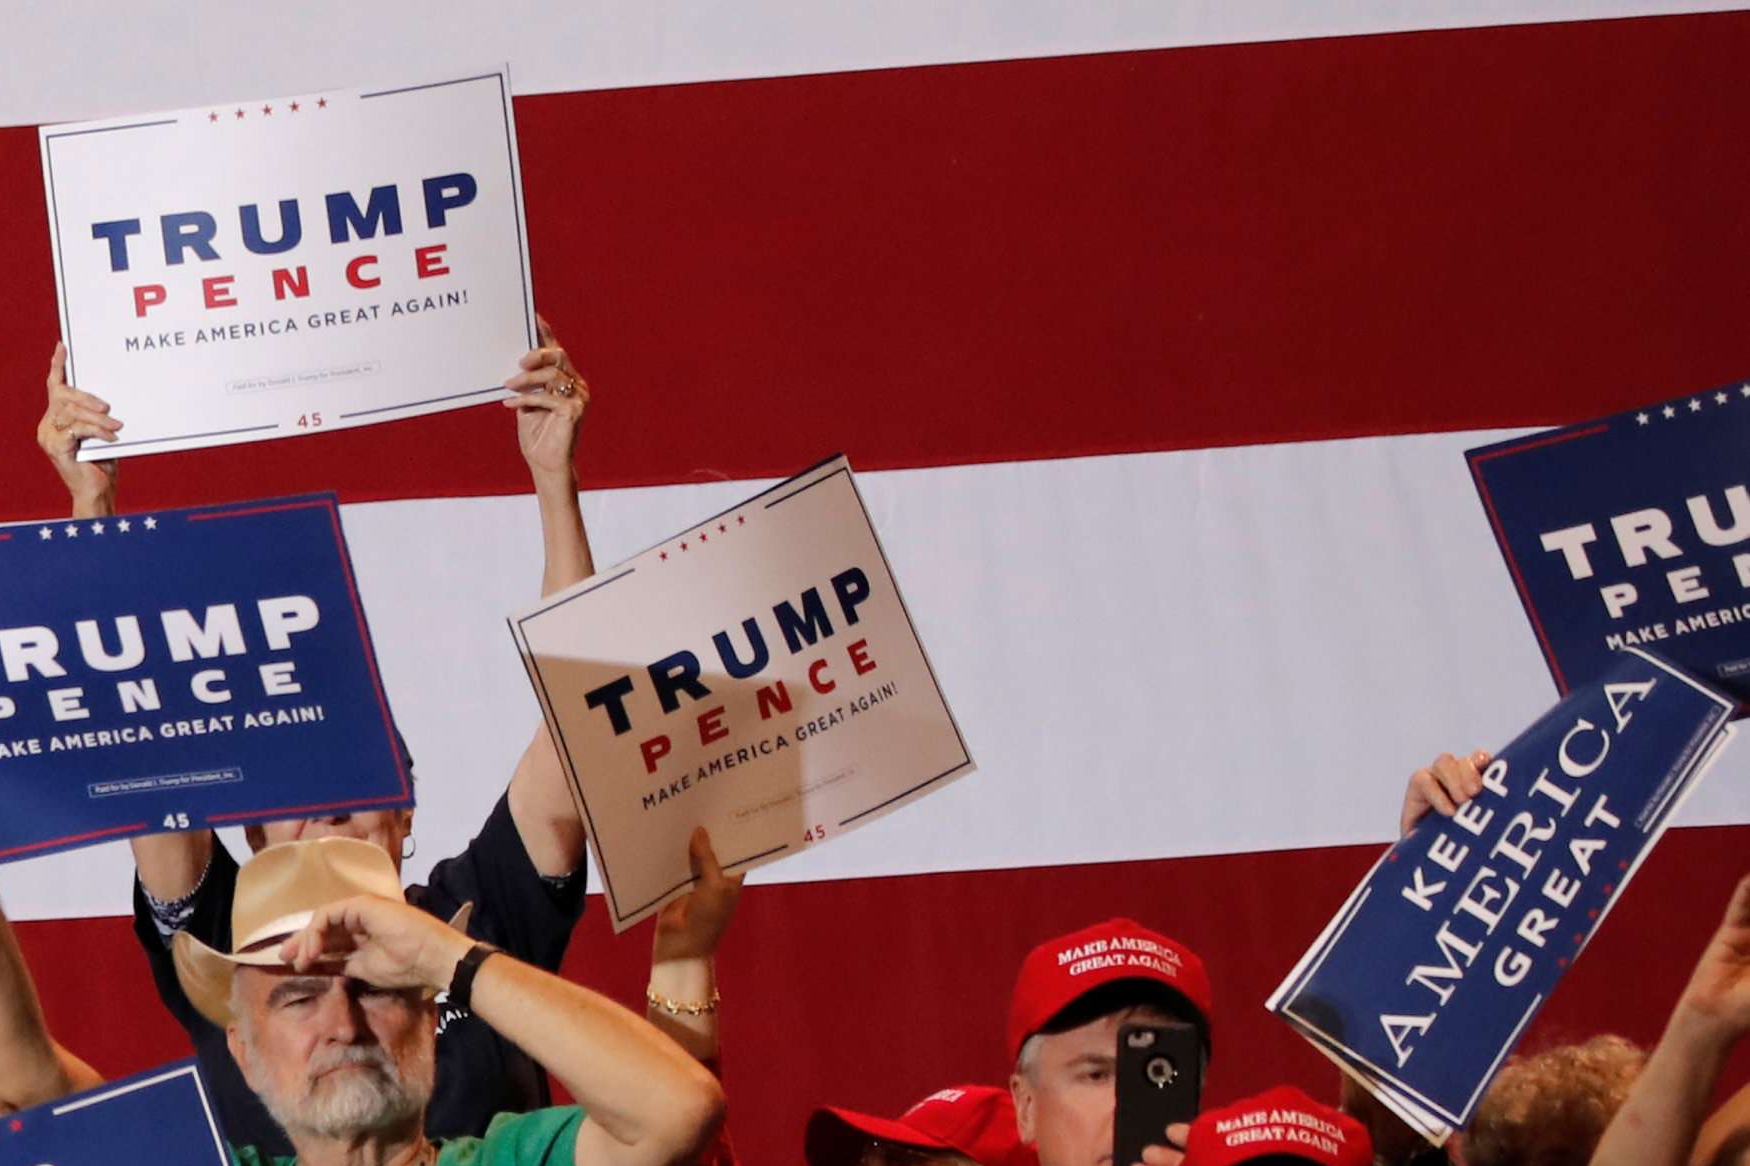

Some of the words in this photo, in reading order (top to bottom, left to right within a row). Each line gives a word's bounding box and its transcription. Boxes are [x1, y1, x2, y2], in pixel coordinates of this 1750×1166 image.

[91, 172, 478, 272] TRUMP
[133, 244, 449, 318] PENCE
[125, 330, 186, 352] MAKE
[195, 319, 298, 344] AMERICA
[307, 305, 381, 329] GREAT
[391, 290, 468, 316] AGAIN!
[297, 412, 323, 428] 45
[1539, 484, 1750, 580] TRU
[585, 566, 871, 736] TRUMP
[1605, 622, 1669, 650] MAKE
[50, 725, 153, 752] AMERICA
[161, 715, 234, 739] GREAT
[244, 706, 325, 727] AGAIN!
[640, 639, 877, 774] PENCE
[641, 774, 692, 811] MAKE
[697, 735, 789, 783] AMERICA
[794, 707, 845, 742] GREAT
[849, 681, 899, 718] AGAIN!
[163, 812, 190, 829] 45
[803, 824, 826, 842] 45
[1401, 758, 1509, 912] KEEP
[1379, 678, 1656, 1069] AMERICA
[1493, 794, 1622, 988] GREAT
[1057, 939, 1108, 966] MAKE
[1110, 936, 1183, 968] AMERICA
[1069, 953, 1126, 976] GREAT
[1127, 954, 1177, 978] AGAIN
[1216, 1111, 1267, 1134] MAKE
[1269, 1109, 1346, 1143] AMERICA
[1226, 1125, 1285, 1147] GREAT
